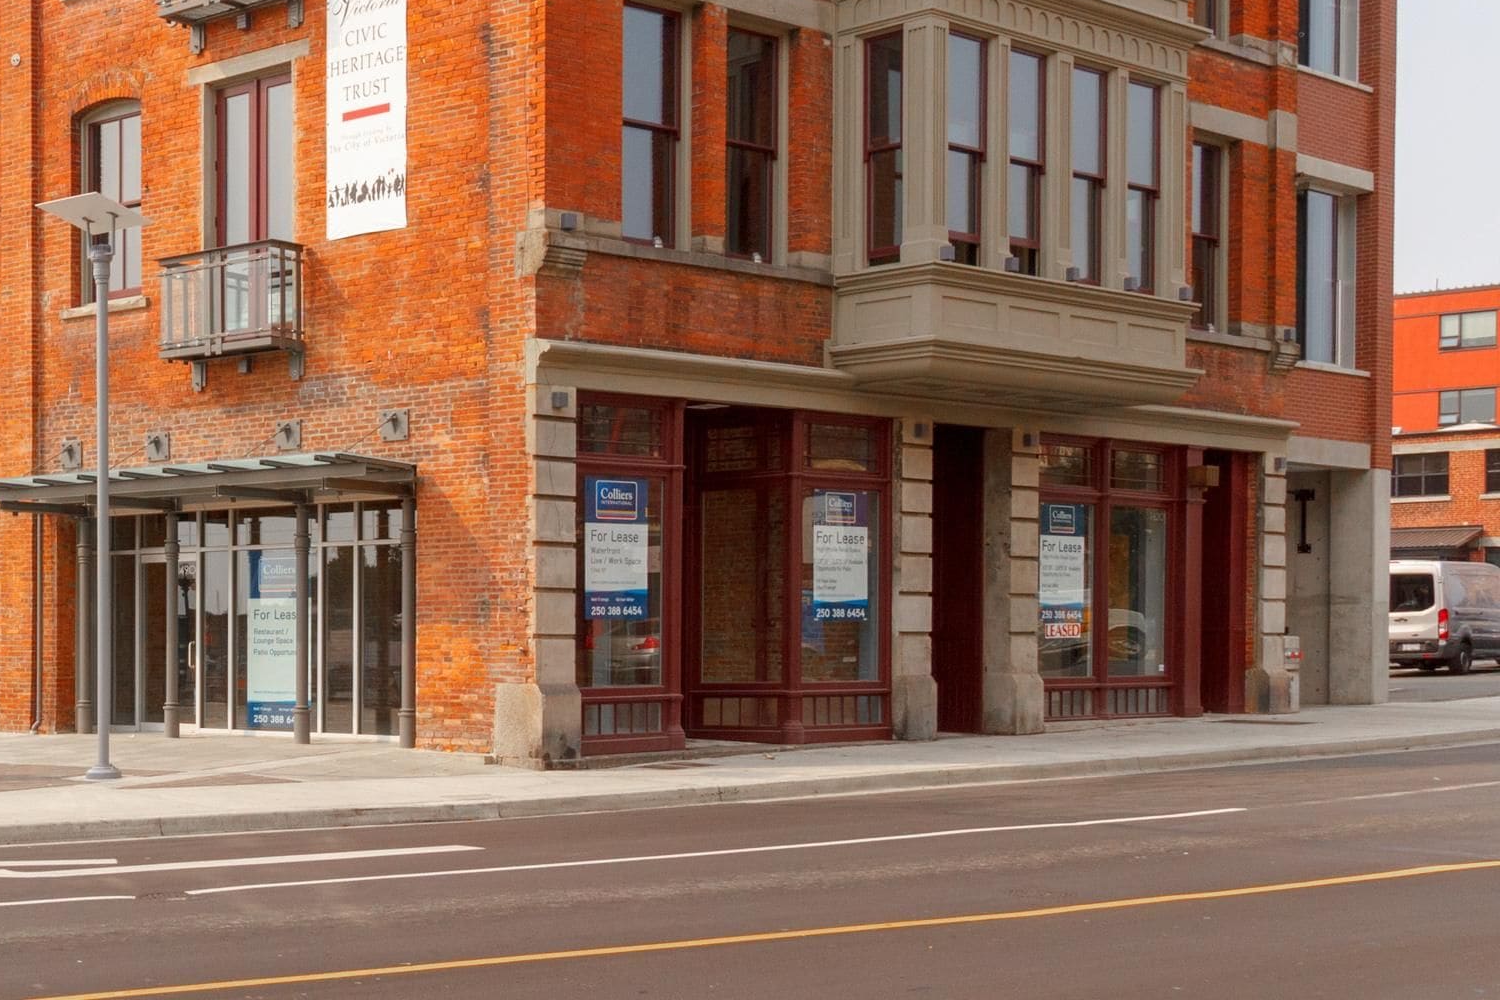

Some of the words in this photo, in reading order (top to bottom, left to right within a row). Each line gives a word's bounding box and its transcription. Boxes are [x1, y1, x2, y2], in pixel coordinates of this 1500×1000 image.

[345, 22, 388, 47] CIVIC
[330, 45, 404, 78] HERITAGE
[342, 77, 390, 102] TRUST
[600, 487, 633, 501] Colliers
[591, 529, 607, 543] For
[611, 529, 639, 543] Lease
[816, 530, 833, 544] For
[836, 531, 865, 545] Lease
[1042, 540, 1056, 551] For
[1058, 541, 1082, 553] Lease
[253, 609, 270, 620] For
[274, 609, 297, 620] Leas
[591, 606, 606, 616] 250
[607, 606, 621, 616] 388
[623, 606, 643, 616] 6454
[816, 608, 831, 618] 250
[832, 608, 845, 618] 388
[846, 609, 866, 618] 6454
[1045, 623, 1080, 638] LEASED
[253, 637, 274, 645] Lounge
[275, 637, 293, 645] Space
[269, 648, 297, 656] Opportun
[253, 714, 268, 723] 250
[270, 715, 285, 724] 388
[286, 715, 296, 724] 64
